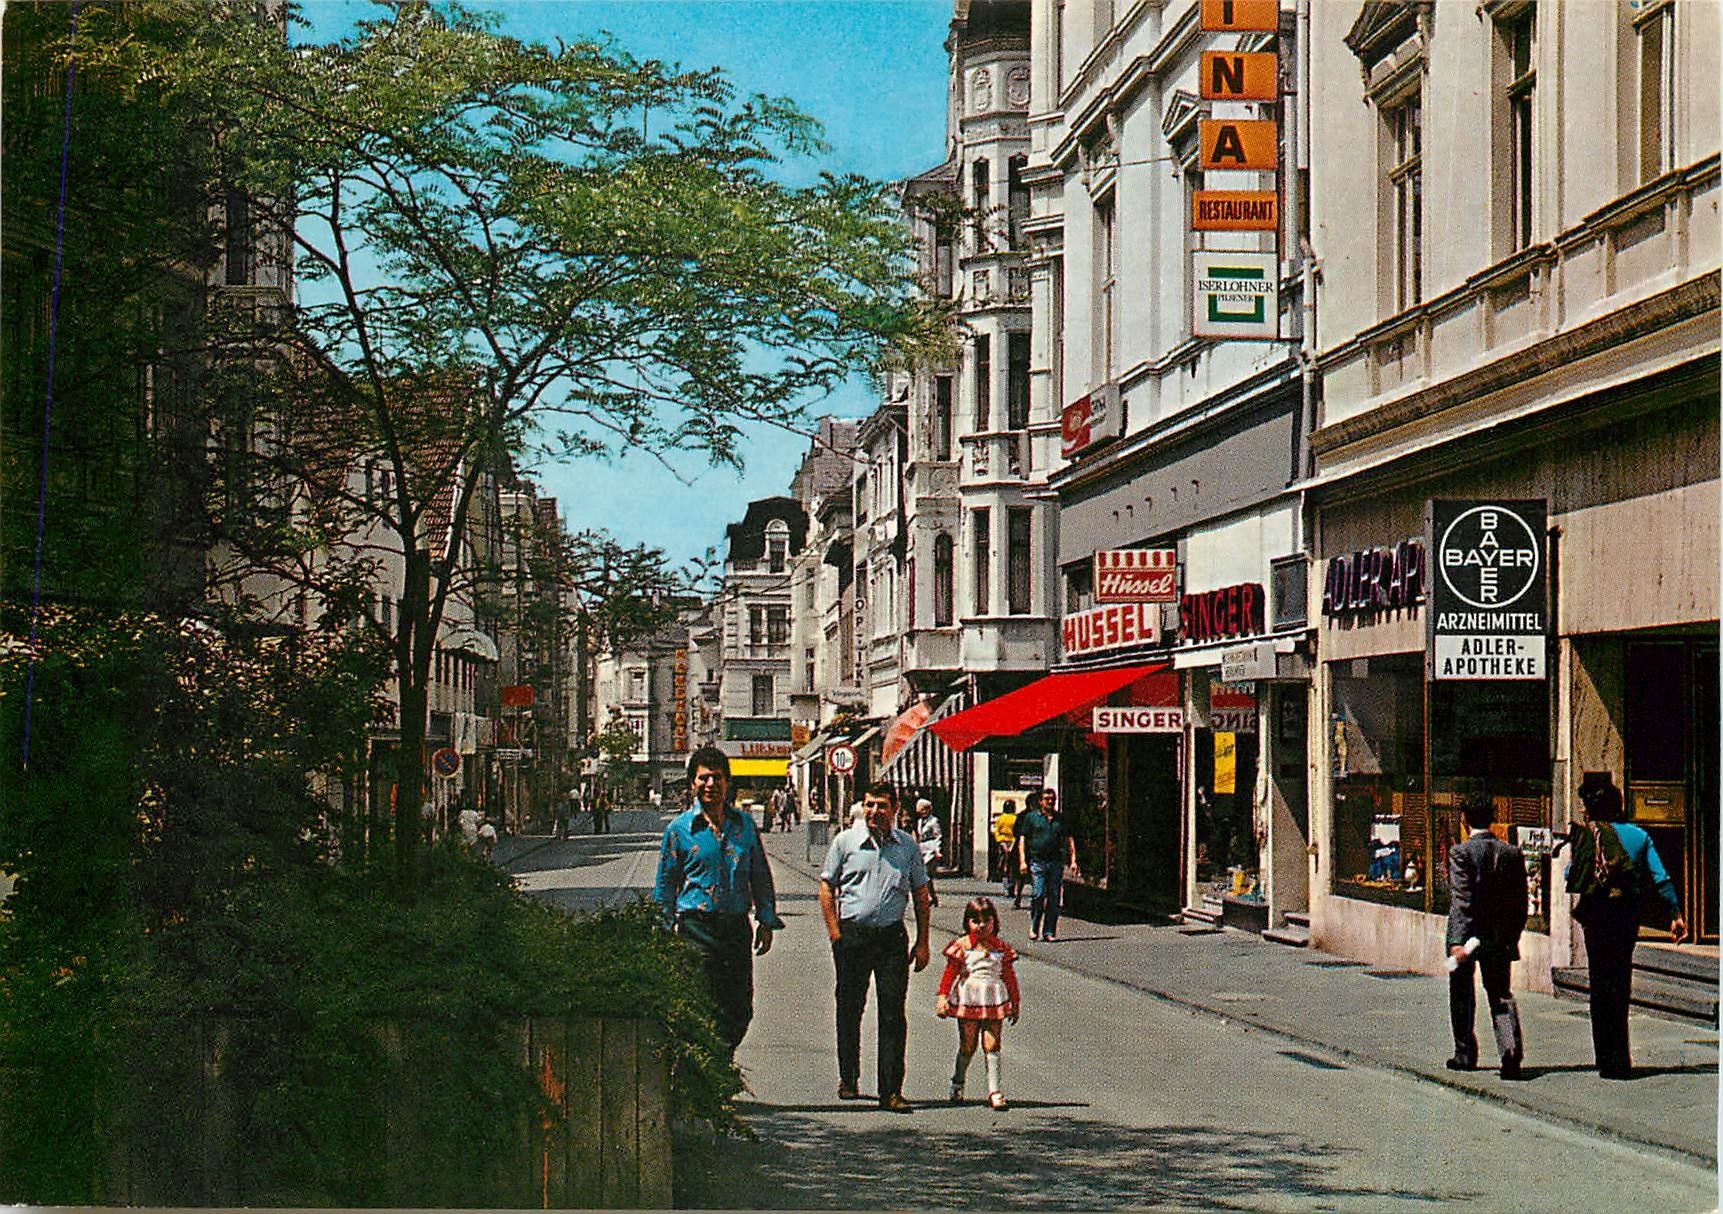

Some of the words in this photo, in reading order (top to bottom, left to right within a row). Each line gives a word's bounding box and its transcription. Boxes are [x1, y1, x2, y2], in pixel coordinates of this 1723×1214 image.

[1200, 200, 1273, 221] RESTAURANT
[1199, 280, 1274, 293] ISERLOHNER
[1218, 294, 1254, 303] PILSENER
[1445, 549, 1534, 567] BAYER
[1480, 512, 1499, 603] BAYER
[1101, 573, 1174, 595] Hüssel
[1181, 584, 1254, 640] SINGER
[1437, 612, 1542, 630] ARZNEIMITTEL
[1461, 638, 1525, 655] ADLER-
[1443, 658, 1536, 675] APOTHEKE
[1099, 712, 1182, 728] SINGER
